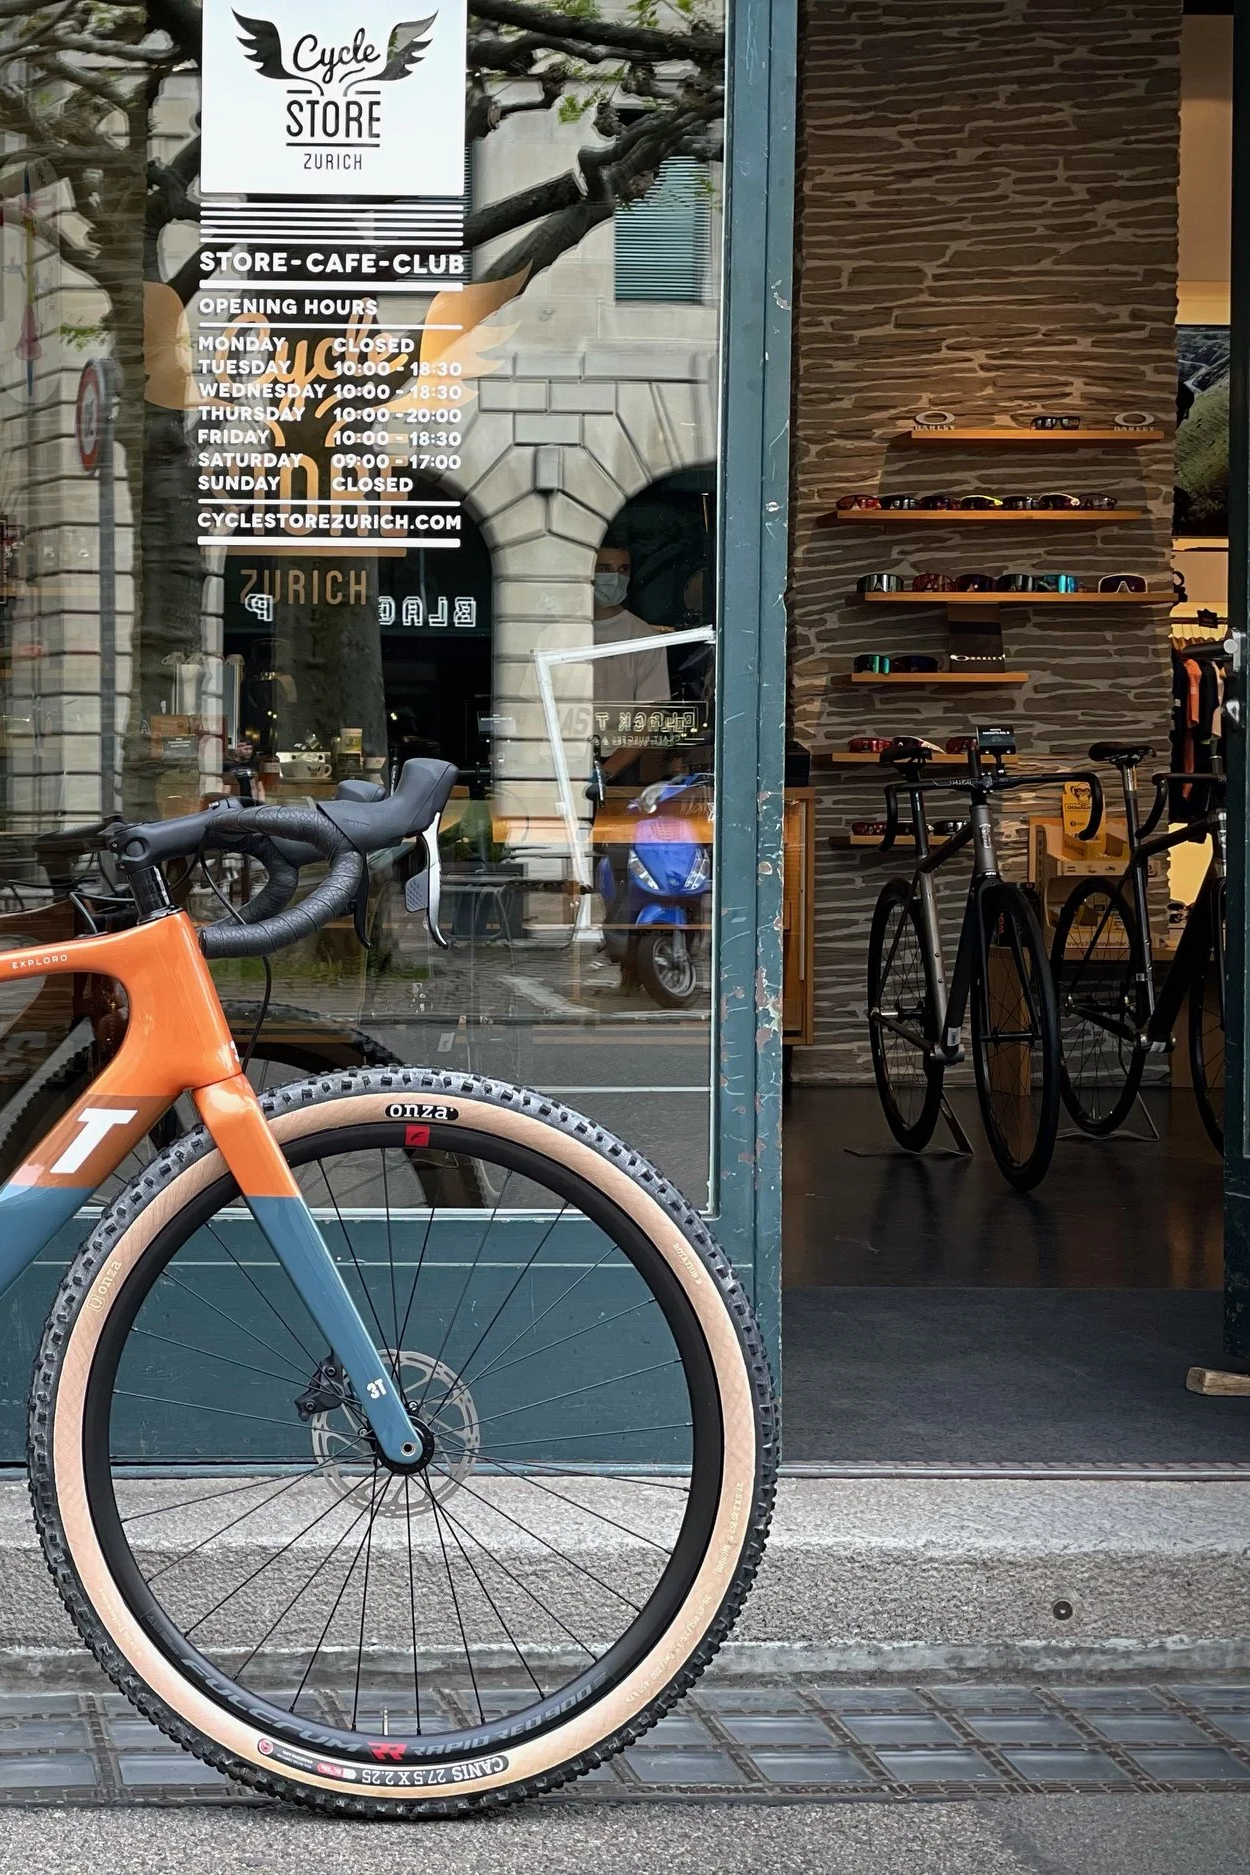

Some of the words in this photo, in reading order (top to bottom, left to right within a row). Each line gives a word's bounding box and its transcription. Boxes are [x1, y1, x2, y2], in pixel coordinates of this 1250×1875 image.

[293, 27, 381, 84] Cycle
[286, 100, 381, 138] STORE
[303, 153, 363, 171] ZURICH
[200, 298, 298, 315] OPENING
[305, 299, 378, 316] HOURS
[199, 336, 286, 352] MONDAY
[333, 337, 415, 353] CLOSED
[199, 359, 291, 375] TUESDAY
[333, 361, 391, 376] 10:00
[410, 361, 463, 377] 18:30
[199, 383, 327, 399] WEDNESDAY
[333, 384, 391, 400] 10:00
[410, 385, 463, 400] 18:30
[199, 406, 306, 422] THURSDAY
[333, 407, 391, 423] 10:00
[406, 408, 462, 424] 20:00
[198, 429, 271, 445] FRIDAY
[333, 430, 390, 446] 10:00
[409, 431, 462, 447] 18:30
[198, 452, 303, 468] SATURDAY
[332, 453, 390, 470] 09:00
[409, 454, 462, 470] 17:00
[198, 475, 281, 491] SUNDAY
[332, 476, 414, 493] CLOSED
[197, 512, 462, 531] CYCLESTOREZURICH.COM
[239, 569, 367, 605] ZURICH
[12, 954, 69, 969] EXPLORO
[389, 1103, 448, 1120] onza
[50, 1107, 138, 1174] T
[98, 1260, 123, 1294] onza
[366, 1378, 388, 1399] 3T
[180, 1658, 362, 1753] FULCRUM
[410, 1735, 490, 1757] RAPID
[494, 1714, 542, 1740] RED
[546, 1683, 592, 1720] 900
[361, 1769, 394, 1785] 2.25
[414, 1768, 446, 1786] 27.5
[452, 1756, 503, 1782] CANIS
[398, 1771, 411, 1786] X
